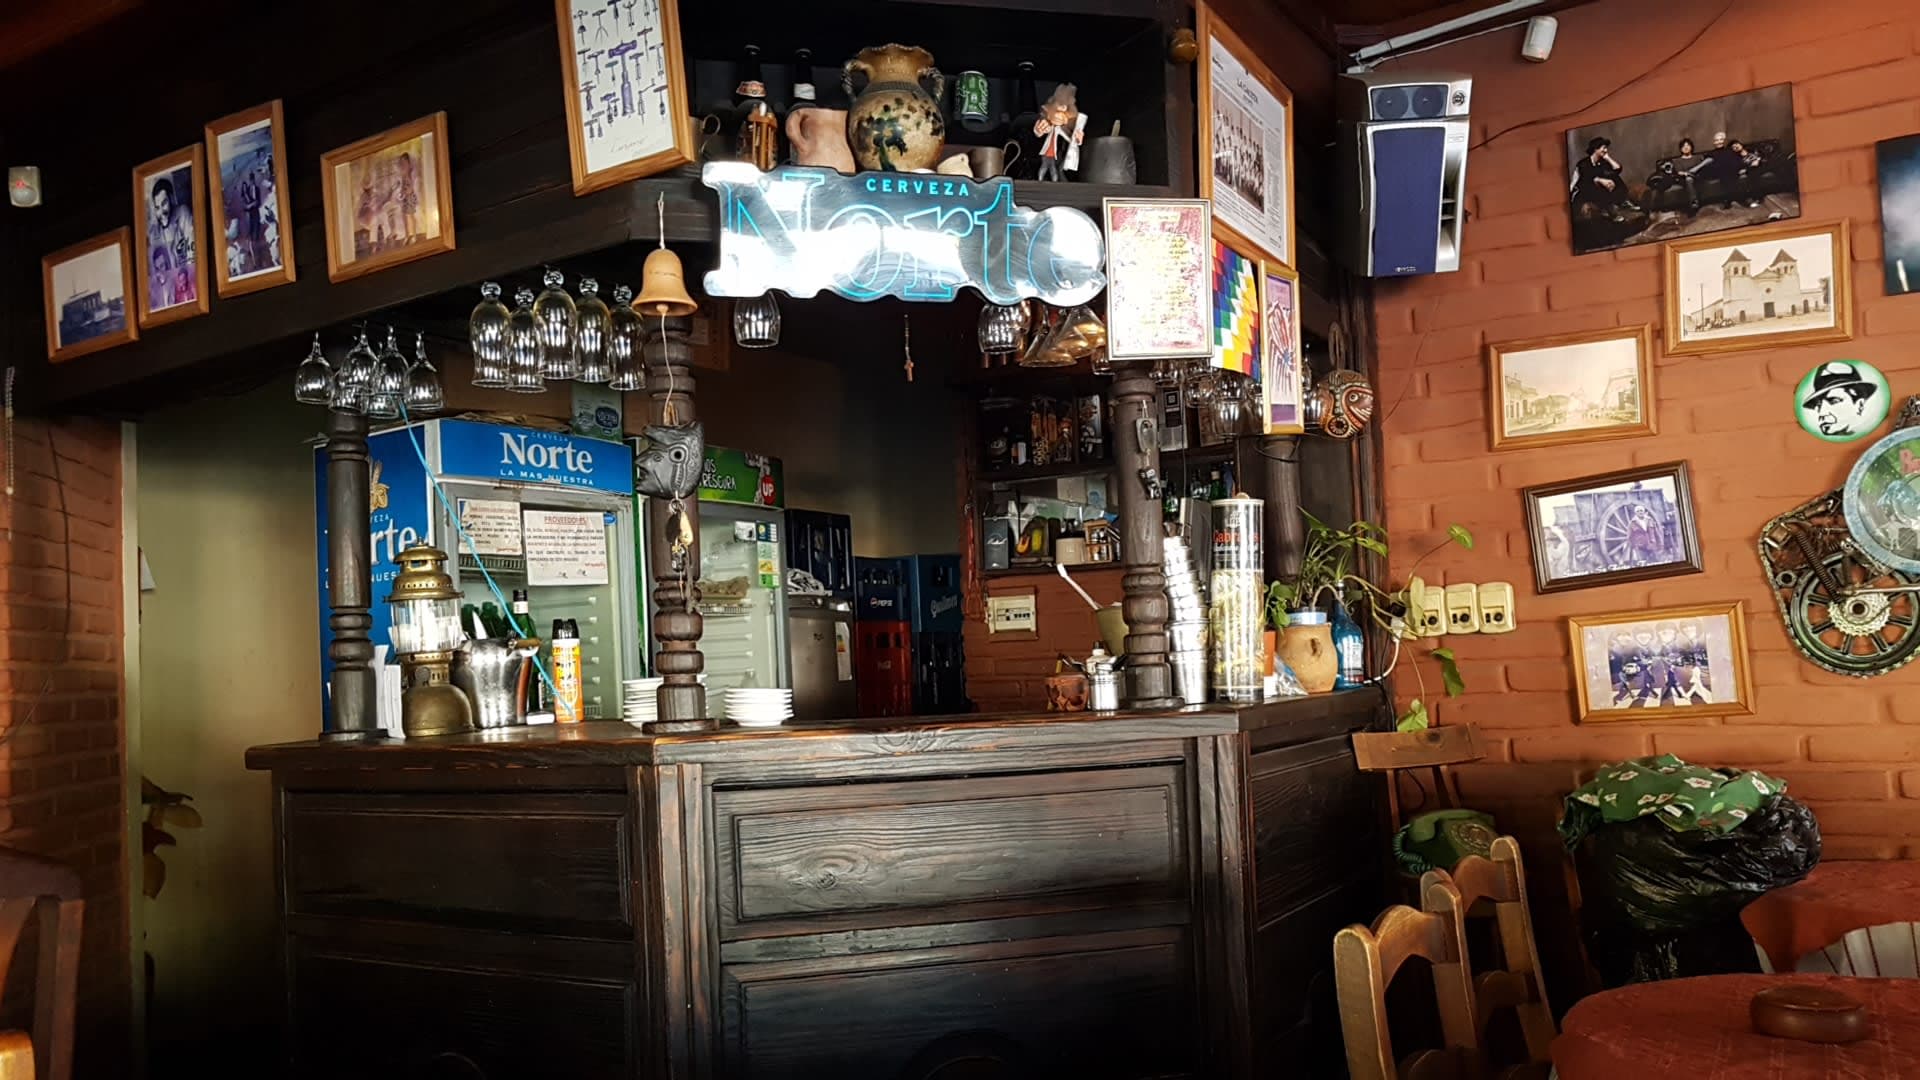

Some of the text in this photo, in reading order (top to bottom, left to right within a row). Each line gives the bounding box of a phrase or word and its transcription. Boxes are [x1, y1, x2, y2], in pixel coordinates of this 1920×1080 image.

[866, 178, 969, 196] CERVEZA
[704, 166, 1104, 302] Norte
[531, 432, 568, 441] CERVEZA
[499, 432, 593, 473] Norte
[520, 471, 543, 479] MAS
[762, 483, 774, 497] UP
